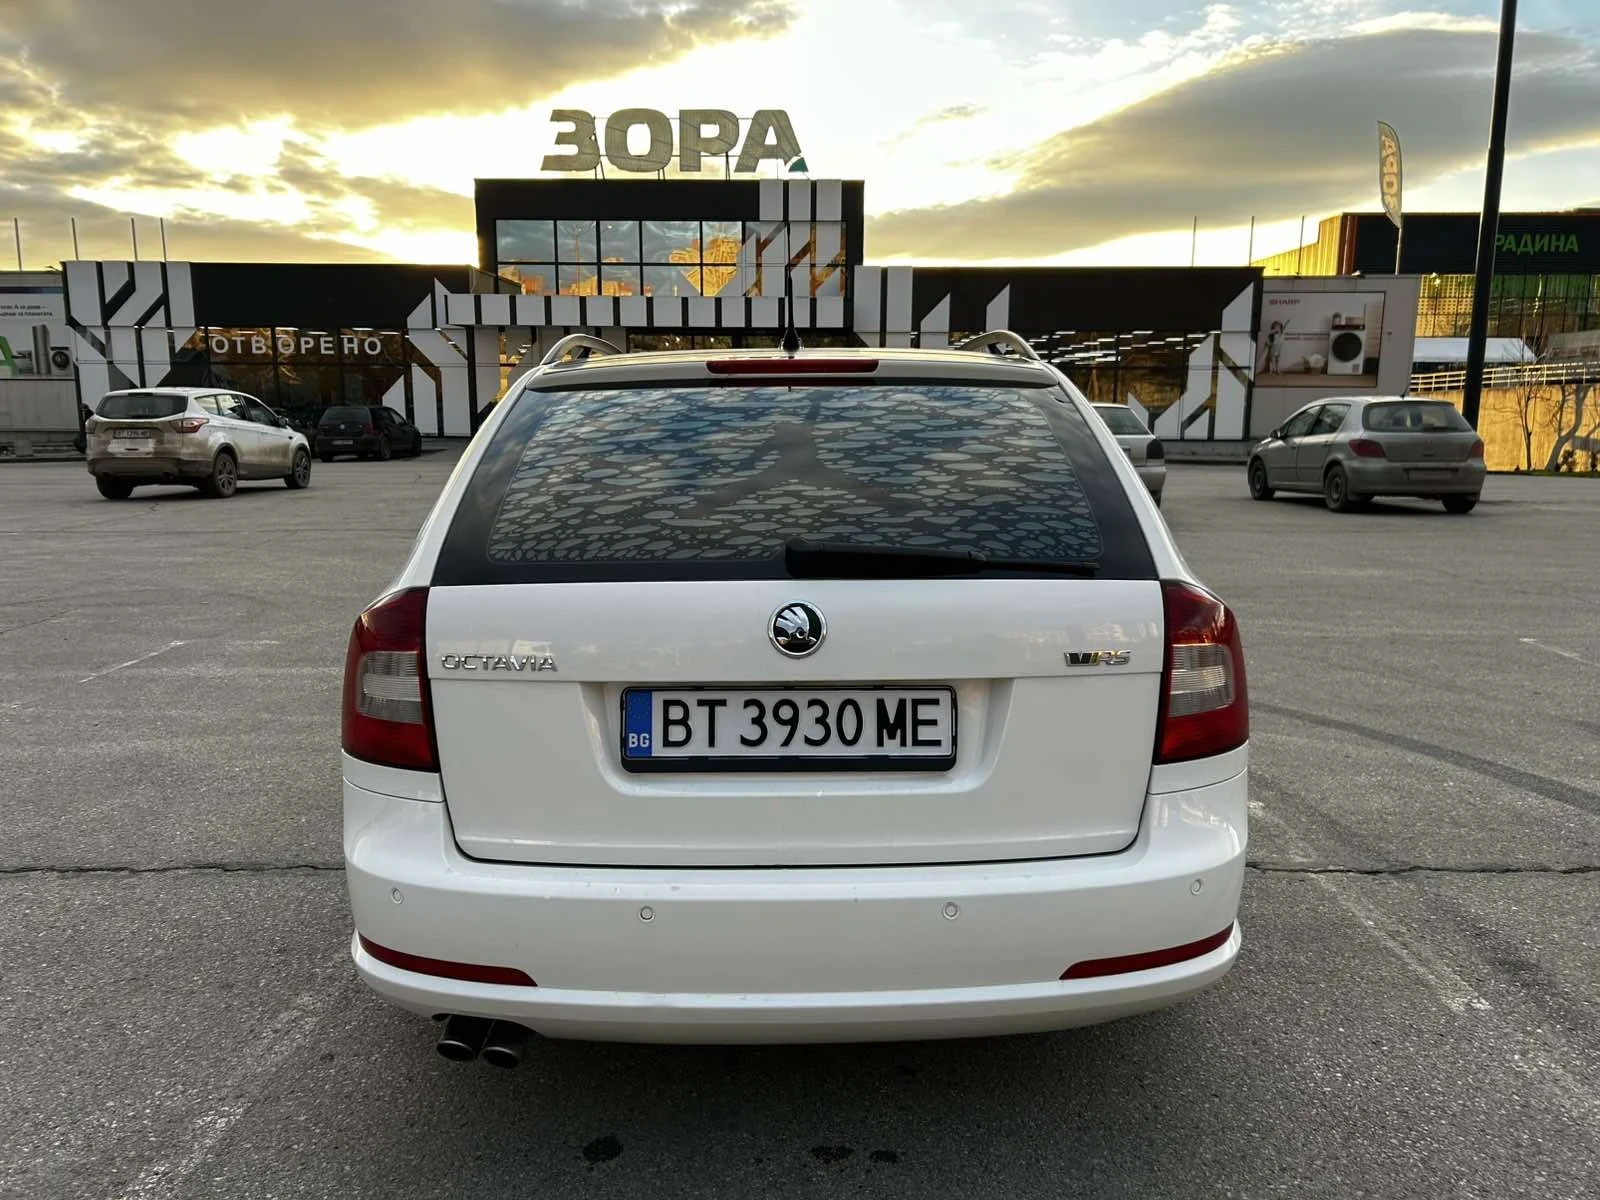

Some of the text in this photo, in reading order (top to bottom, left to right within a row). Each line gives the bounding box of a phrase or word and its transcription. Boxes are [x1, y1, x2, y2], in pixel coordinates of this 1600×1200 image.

[540, 108, 809, 173] ЗОРА
[1495, 232, 1579, 256] РАДИНА
[211, 336, 382, 355] ОТВОРЕНО
[441, 653, 558, 672] OCTAVIA
[662, 697, 943, 748] BT 3930 ME
[628, 733, 650, 748] BG
